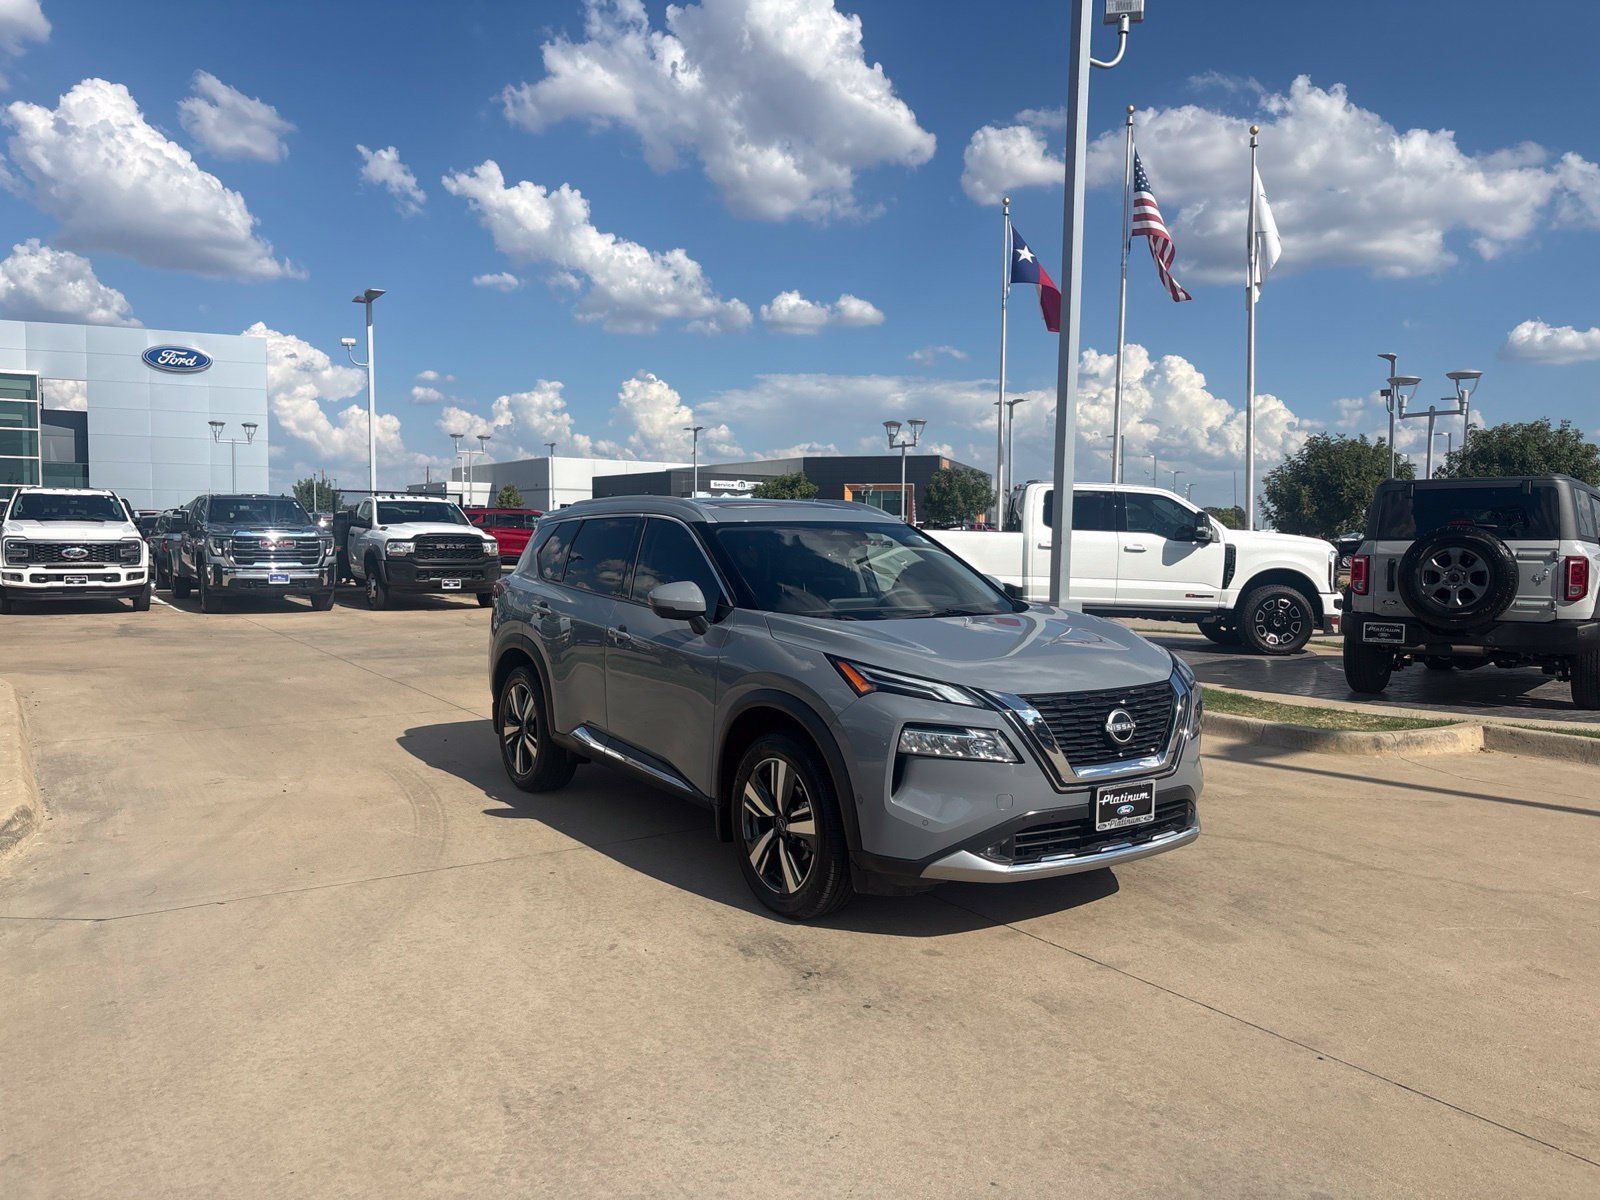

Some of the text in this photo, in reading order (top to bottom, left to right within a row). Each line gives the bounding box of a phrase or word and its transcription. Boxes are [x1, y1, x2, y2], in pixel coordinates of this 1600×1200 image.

[157, 350, 196, 366] Ford
[1106, 722, 1136, 731] NISSAN
[1099, 792, 1150, 806] Platinum
